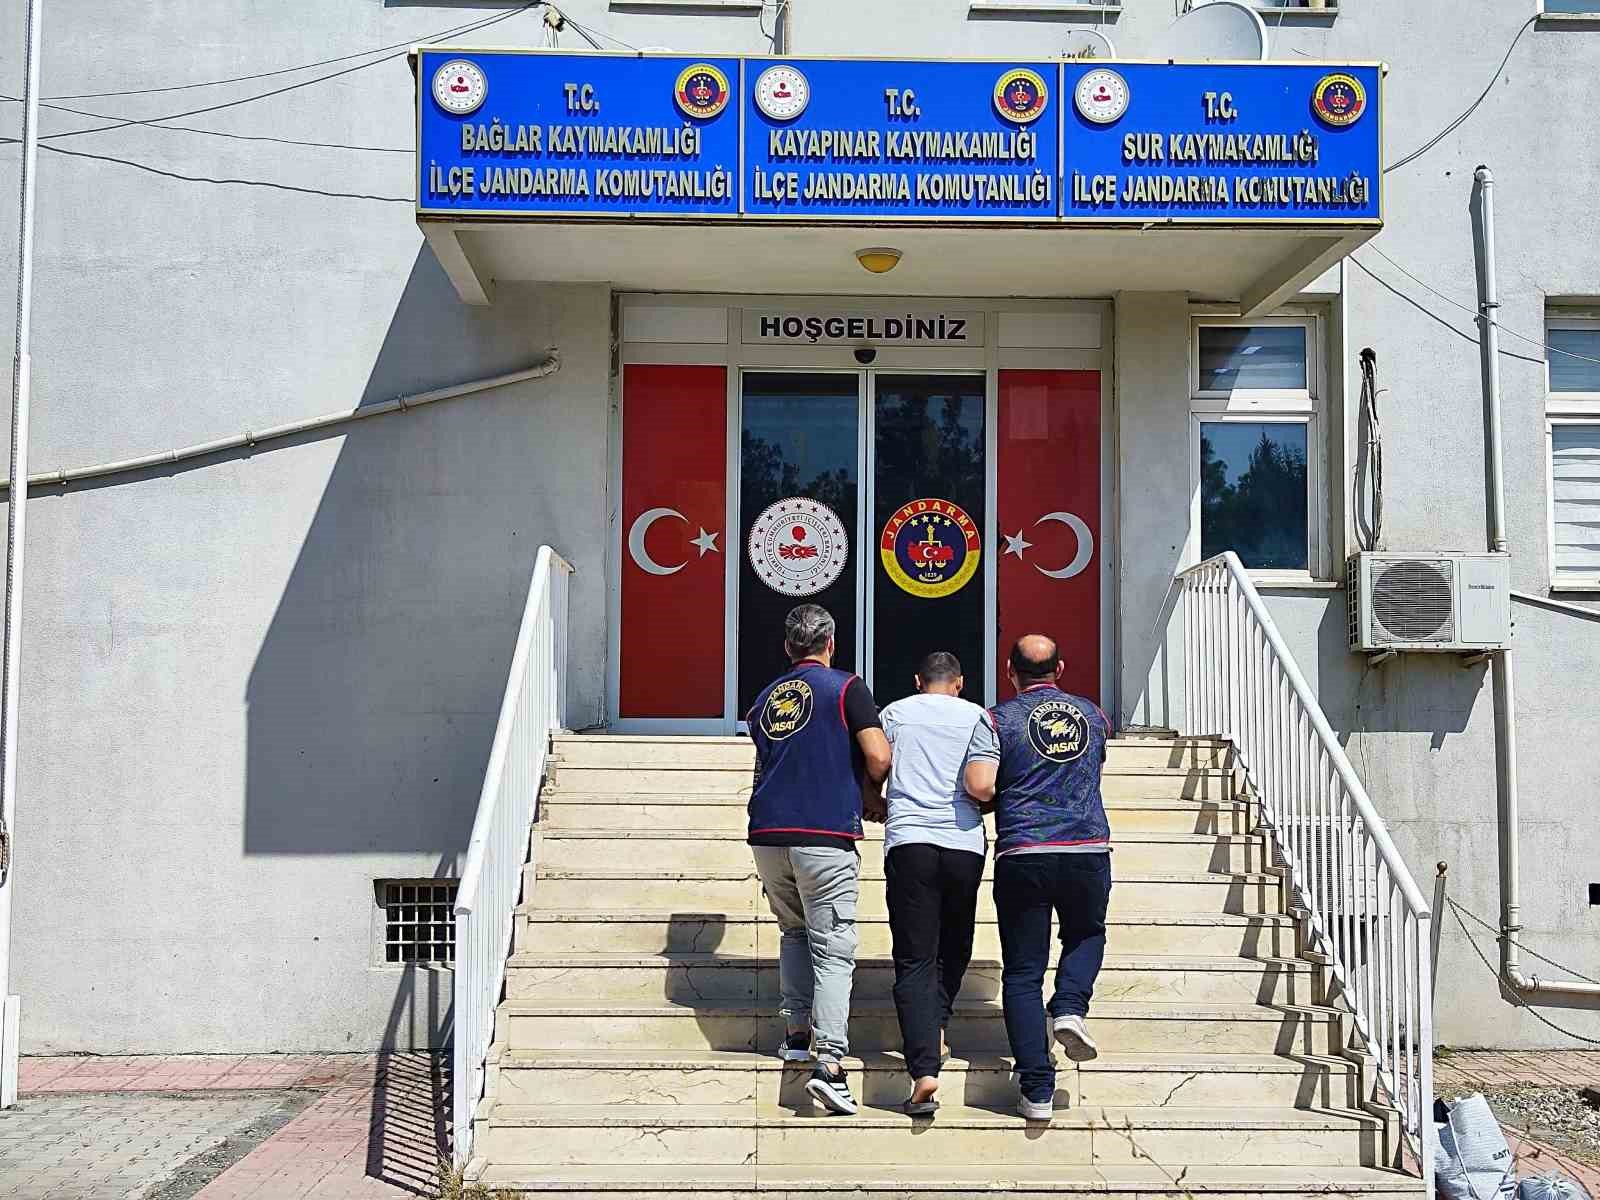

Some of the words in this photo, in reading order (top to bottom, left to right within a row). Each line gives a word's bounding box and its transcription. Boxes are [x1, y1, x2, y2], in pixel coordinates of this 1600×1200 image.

[565, 83, 600, 111] T.C.
[886, 88, 921, 115] T.C.
[1205, 91, 1238, 118] T.C.
[462, 116, 542, 152] BAĞLAR
[548, 121, 701, 155] KAYMAKAMLIĞI
[769, 128, 880, 157] KAYAPINAR
[886, 125, 1036, 159] KAYMAKAMLIĞI
[1123, 132, 1164, 160] SUR
[1169, 128, 1319, 161] KAYMAKAMLIĞI
[430, 160, 474, 196] İLÇE
[480, 166, 587, 196] JANDARMA
[596, 164, 732, 198] KOMUTANLIĞI
[754, 166, 798, 201] İLÇE
[804, 171, 910, 200] JANDARMA
[916, 168, 1051, 201] KOMUTANLIĞI
[1074, 170, 1117, 204] İLÇE
[1123, 175, 1229, 202] JANDARMA
[1235, 170, 1369, 204] KOMUTANLIĞI
[760, 314, 966, 343] HOŞGELDİNİZ
[886, 501, 976, 540] JANDARMA
[769, 720, 798, 733] JASAT
[1031, 703, 1083, 722] JANDARMA
[1046, 742, 1080, 755] JASAT
